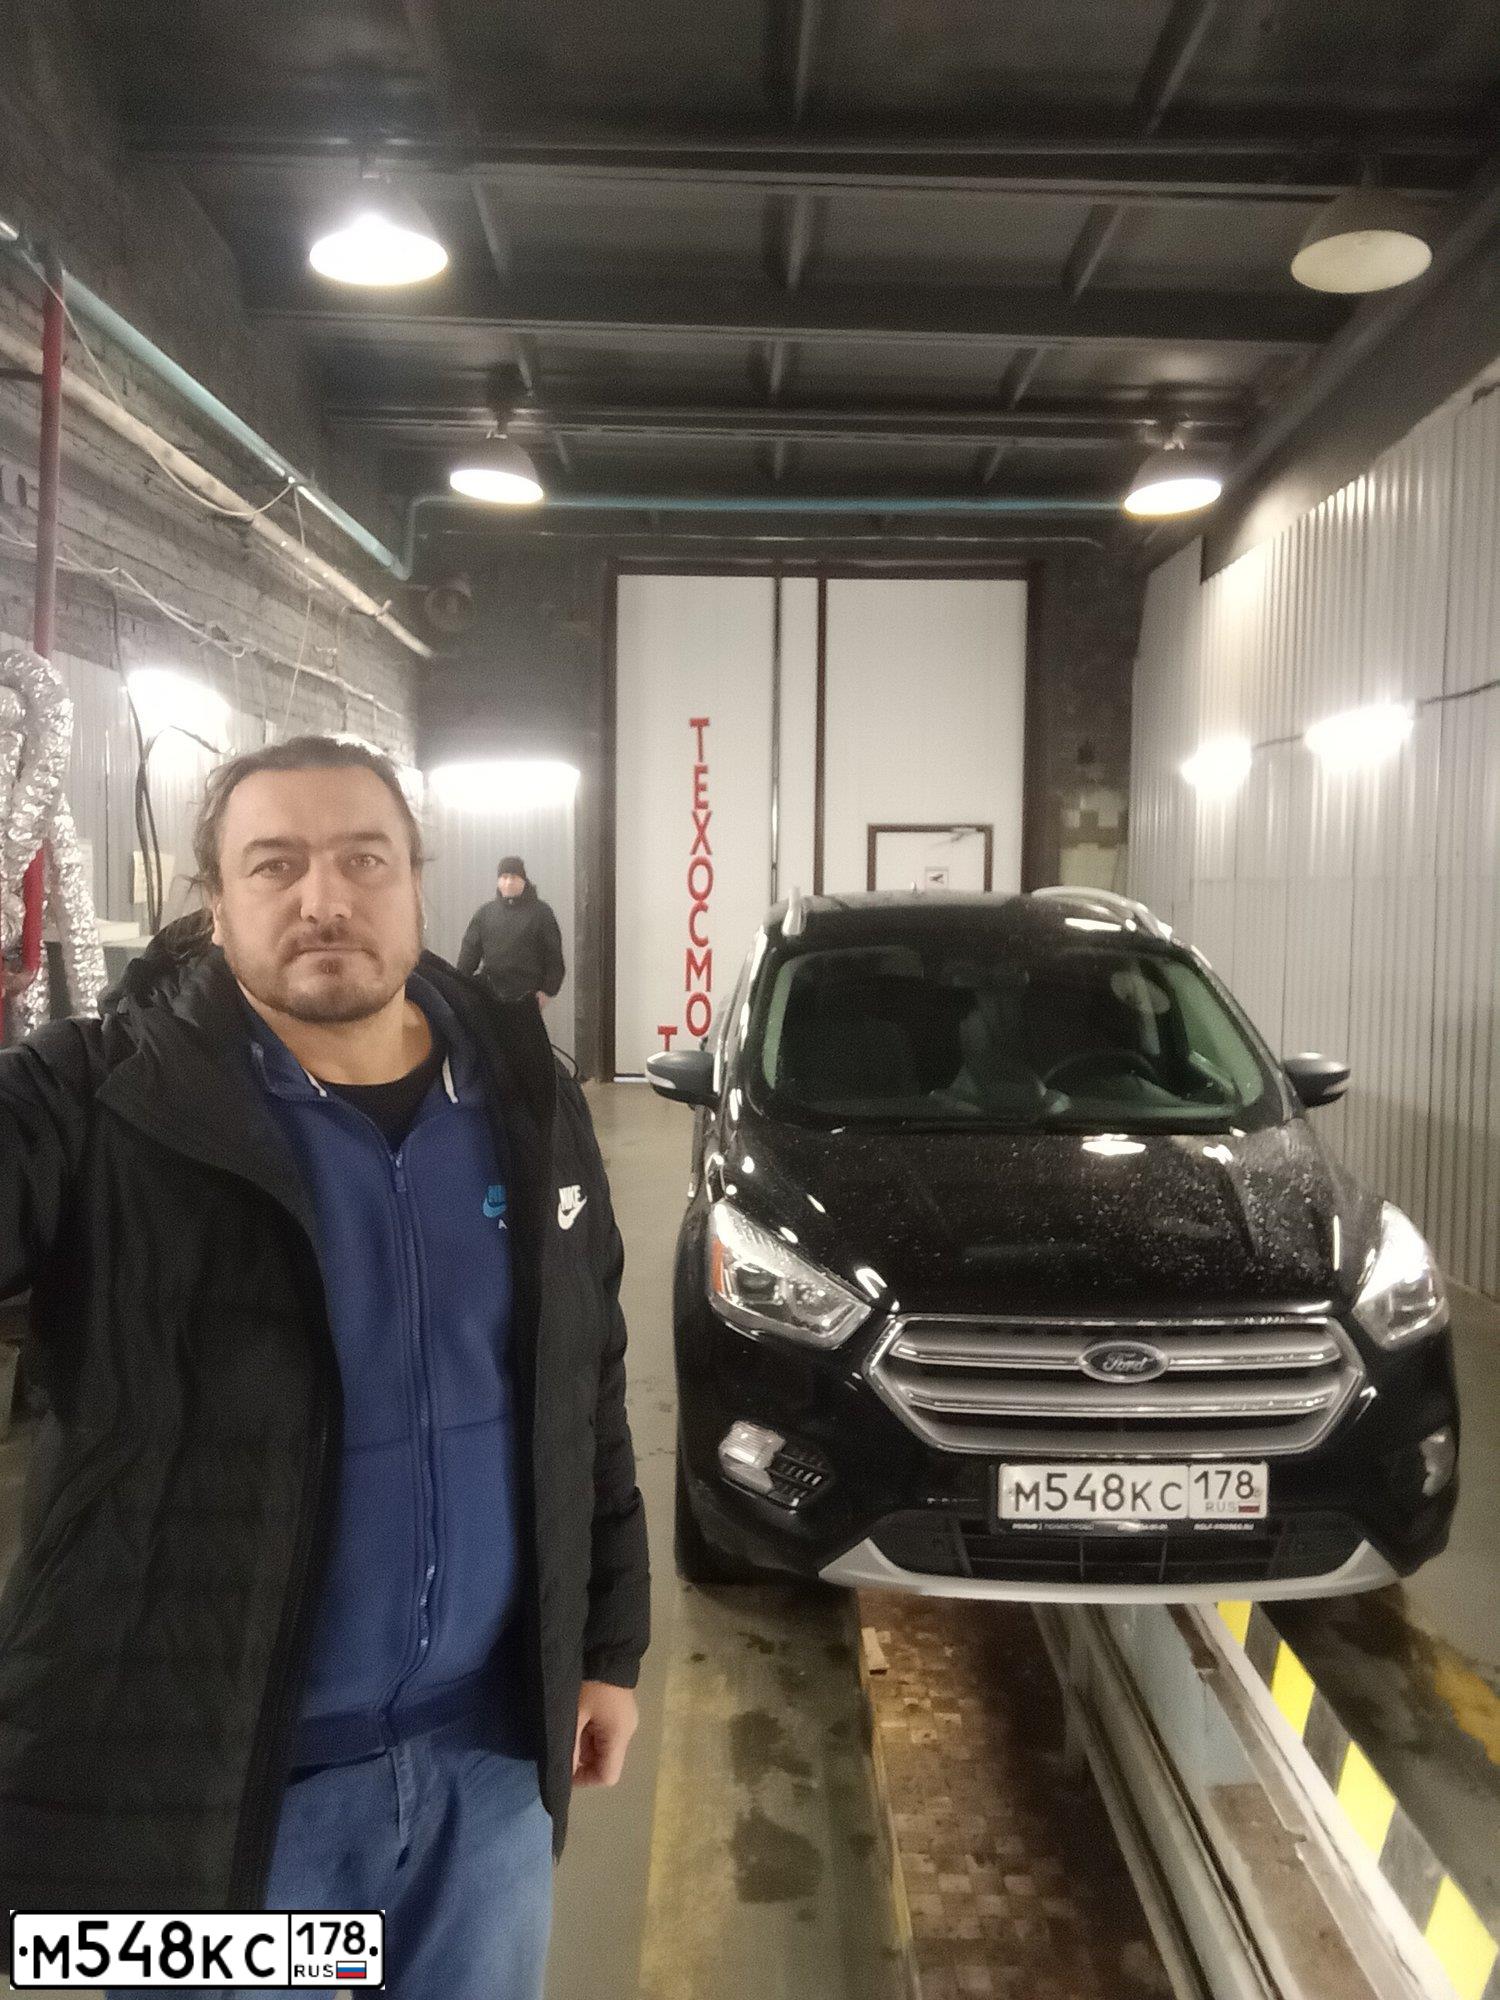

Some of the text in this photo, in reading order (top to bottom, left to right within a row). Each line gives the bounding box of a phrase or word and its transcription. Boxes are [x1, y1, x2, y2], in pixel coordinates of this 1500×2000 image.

[1102, 1352, 1156, 1372] Ford
[1014, 1470, 1254, 1512] М548КС 178
[1205, 1502, 1236, 1513] RUS
